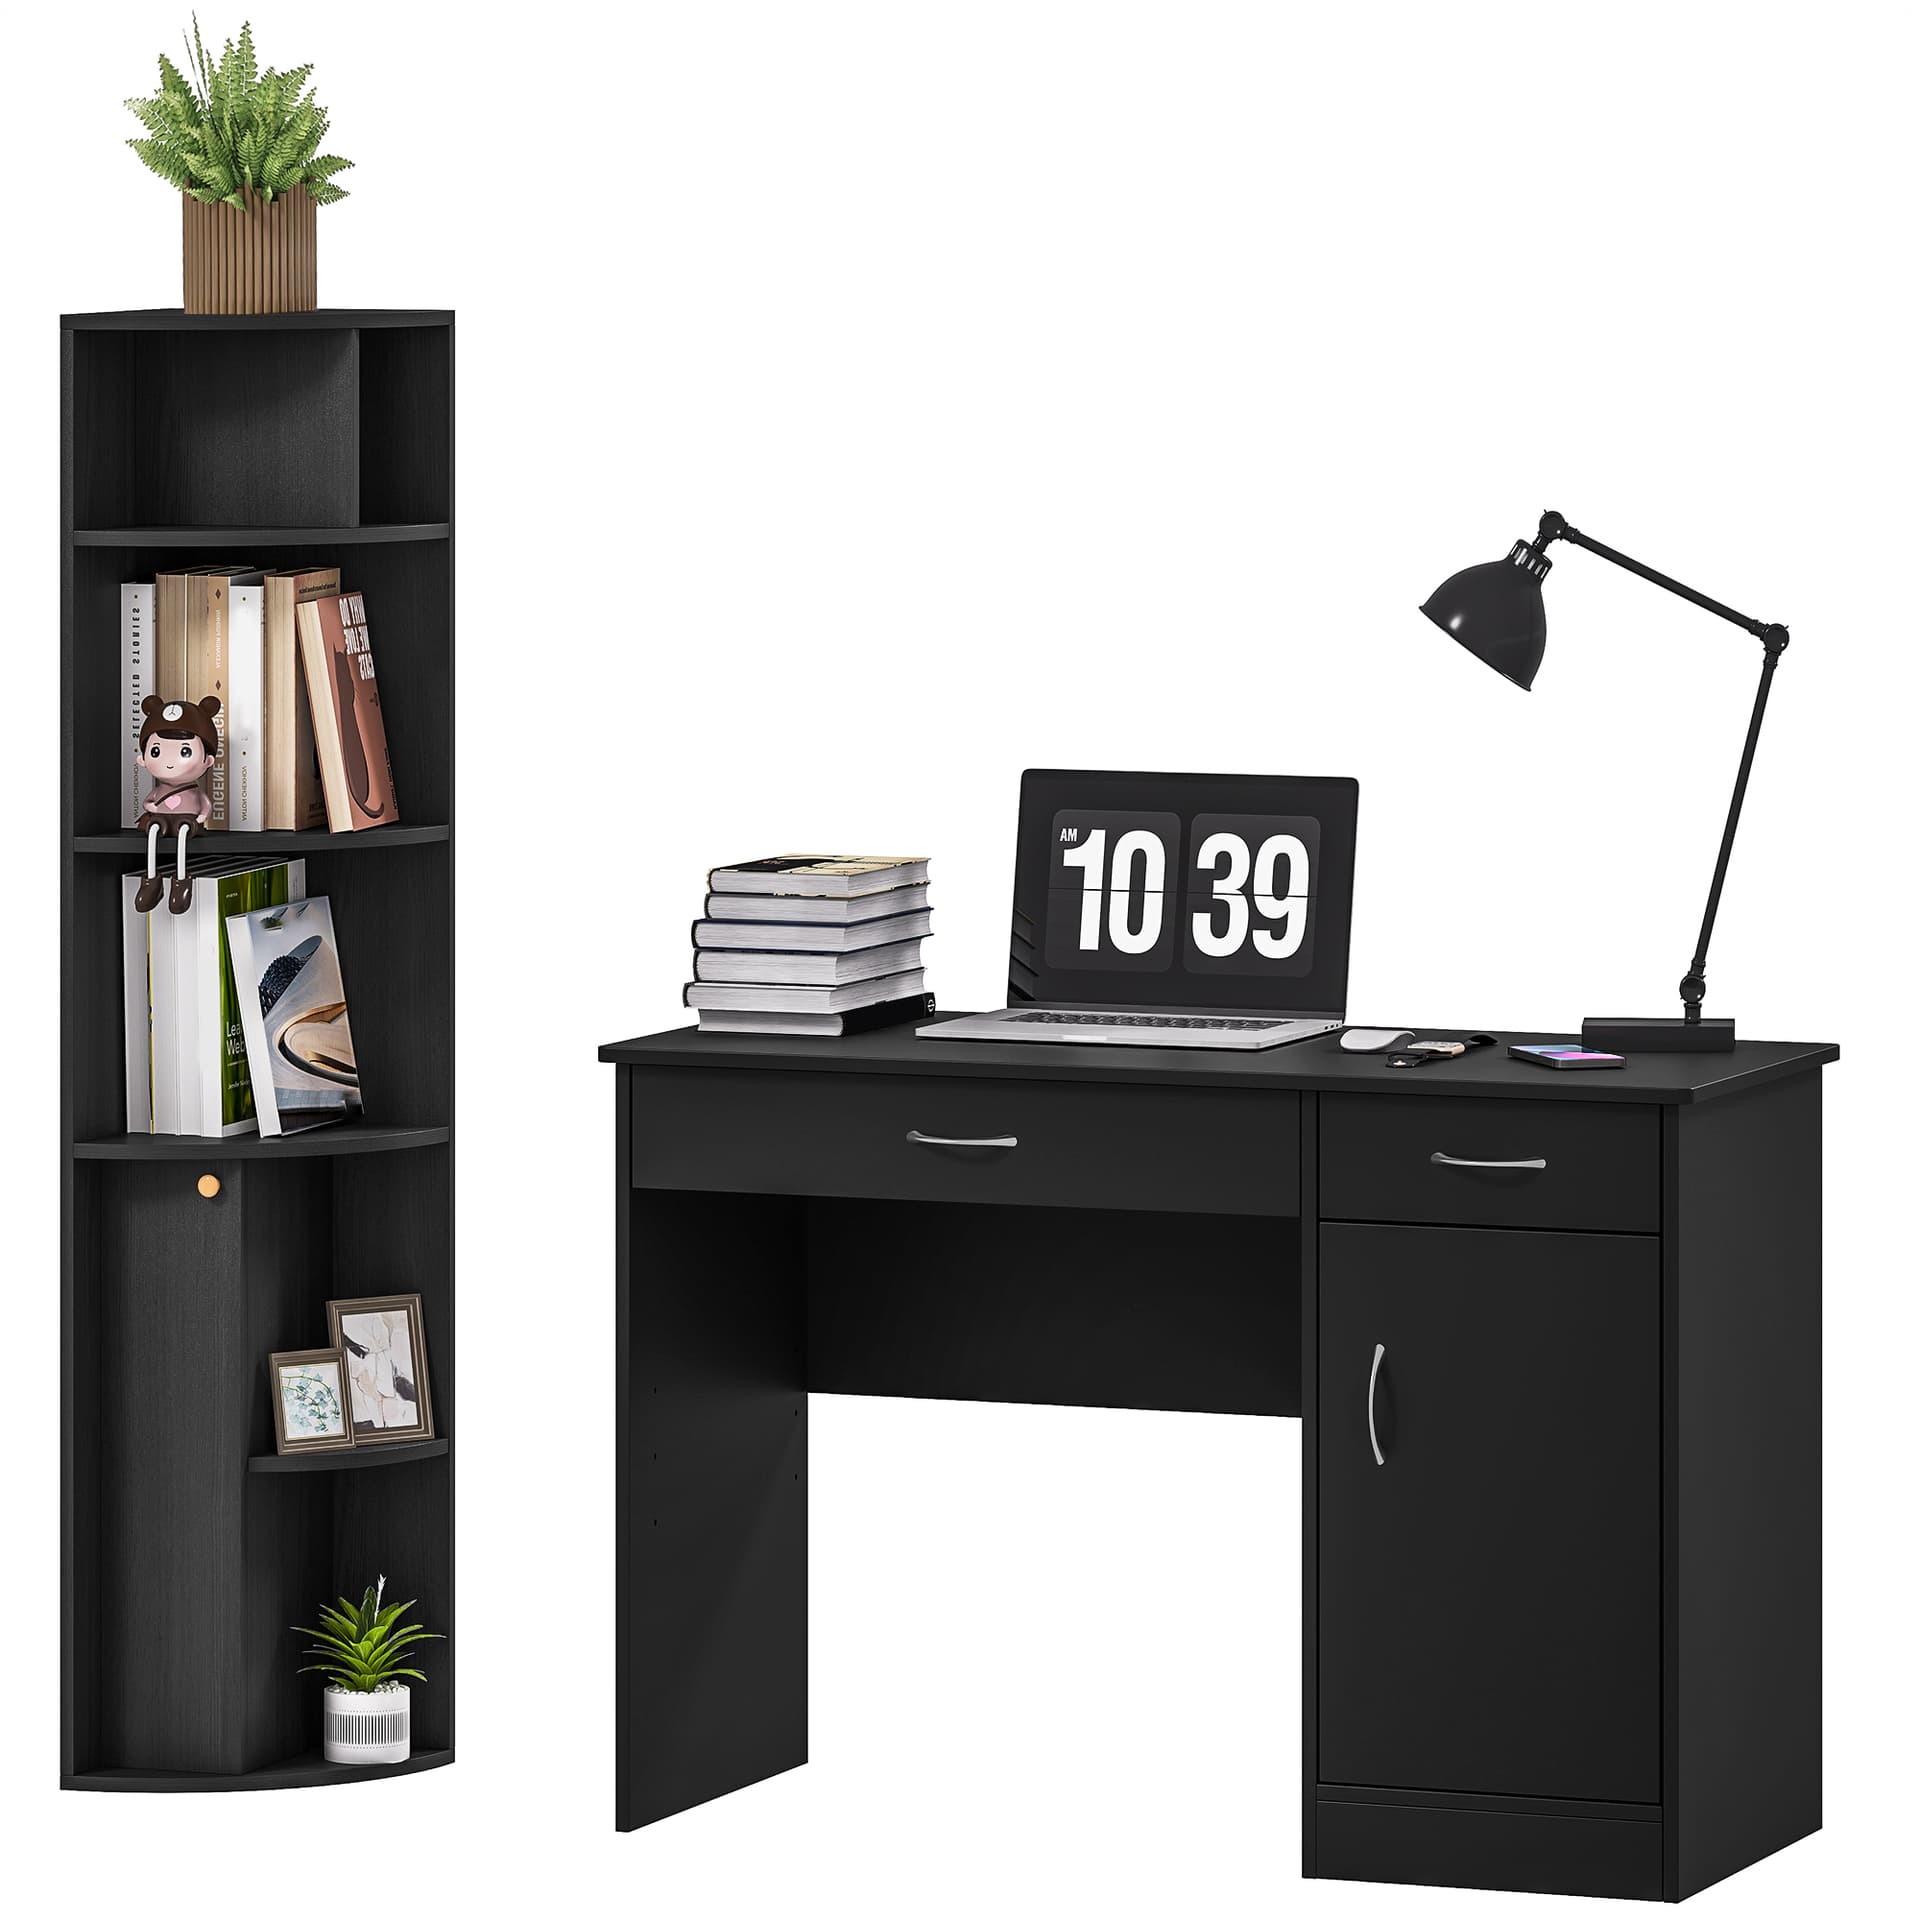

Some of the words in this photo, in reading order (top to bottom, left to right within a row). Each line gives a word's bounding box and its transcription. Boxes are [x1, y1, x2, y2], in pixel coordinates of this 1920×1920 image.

[1060, 828, 1078, 842] AM
[1062, 829, 1166, 954] 10
[1191, 832, 1310, 960] 39
